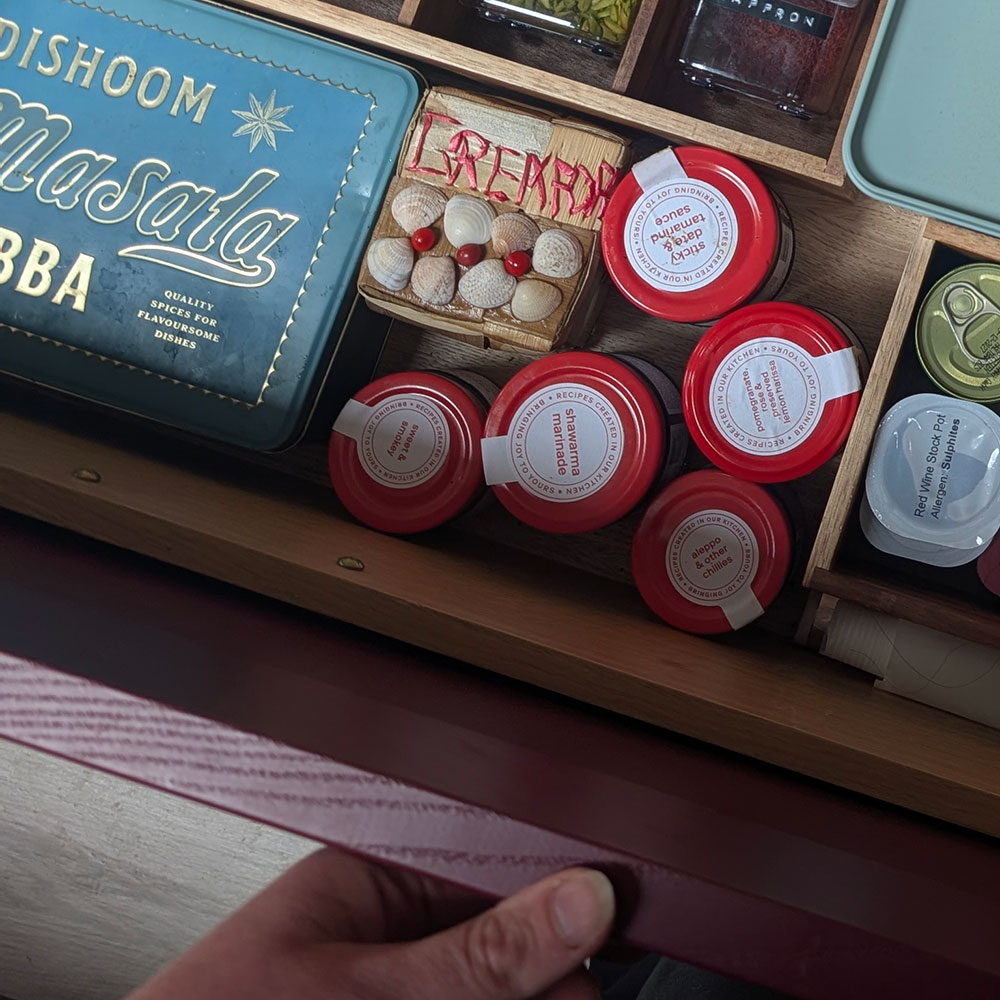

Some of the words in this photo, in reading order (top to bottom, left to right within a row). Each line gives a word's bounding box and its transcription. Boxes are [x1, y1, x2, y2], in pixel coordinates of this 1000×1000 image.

[0, 16, 216, 124] DISHOOM
[643, 197, 655, 209] TO
[656, 188, 671, 199] JOY
[674, 186, 715, 204] BRINGING
[633, 208, 647, 237] YOURS
[656, 205, 690, 226] sauce
[651, 214, 706, 244] tamarind
[676, 228, 703, 246] date
[716, 209, 729, 247] RECIPES
[662, 242, 673, 252] &
[670, 241, 706, 265] sticky
[634, 247, 661, 277] KITCHEN
[694, 248, 725, 279] CREATED
[662, 273, 680, 283] OUR
[683, 274, 692, 282] IN
[164, 290, 214, 311] QUALITY
[150, 300, 193, 320] SPICES
[194, 312, 218, 327] FOR
[137, 310, 220, 342] FLAVOURSOME
[154, 329, 196, 349] DISHES
[725, 346, 760, 372] KITCHEN
[771, 345, 799, 361] YOURS
[797, 359, 809, 372] TO
[717, 372, 729, 392] OUR
[769, 360, 782, 396] harissa
[805, 372, 816, 389] JOY
[555, 391, 594, 404] RECIPES
[716, 395, 723, 404] IN
[758, 392, 768, 412] rose
[761, 372, 780, 418] preserved
[514, 396, 545, 438] BRINGING
[593, 400, 618, 438] CREATED
[778, 398, 790, 424] lemon
[792, 393, 816, 437] BRINGING
[717, 407, 745, 442] CREATED
[933, 414, 946, 432] Pot
[387, 420, 408, 457] smokey
[404, 424, 419, 453] sweet
[552, 414, 566, 476] marinade
[566, 408, 580, 476] shawarma
[610, 441, 618, 451] IN
[745, 436, 785, 449] RECIPES
[928, 436, 942, 464] Stock
[514, 443, 523, 459] JOY
[518, 461, 529, 474] TO
[601, 453, 615, 473] OUR
[930, 472, 949, 519] Allergen:
[942, 418, 960, 470] Sulphites
[526, 472, 555, 494] YOURS
[565, 472, 604, 495] KITCHEN
[920, 468, 934, 498] Wine
[914, 497, 928, 518] Red
[691, 536, 721, 560] aleppo
[696, 561, 704, 570] &
[705, 544, 728, 564] other
[702, 556, 733, 579] chillies
